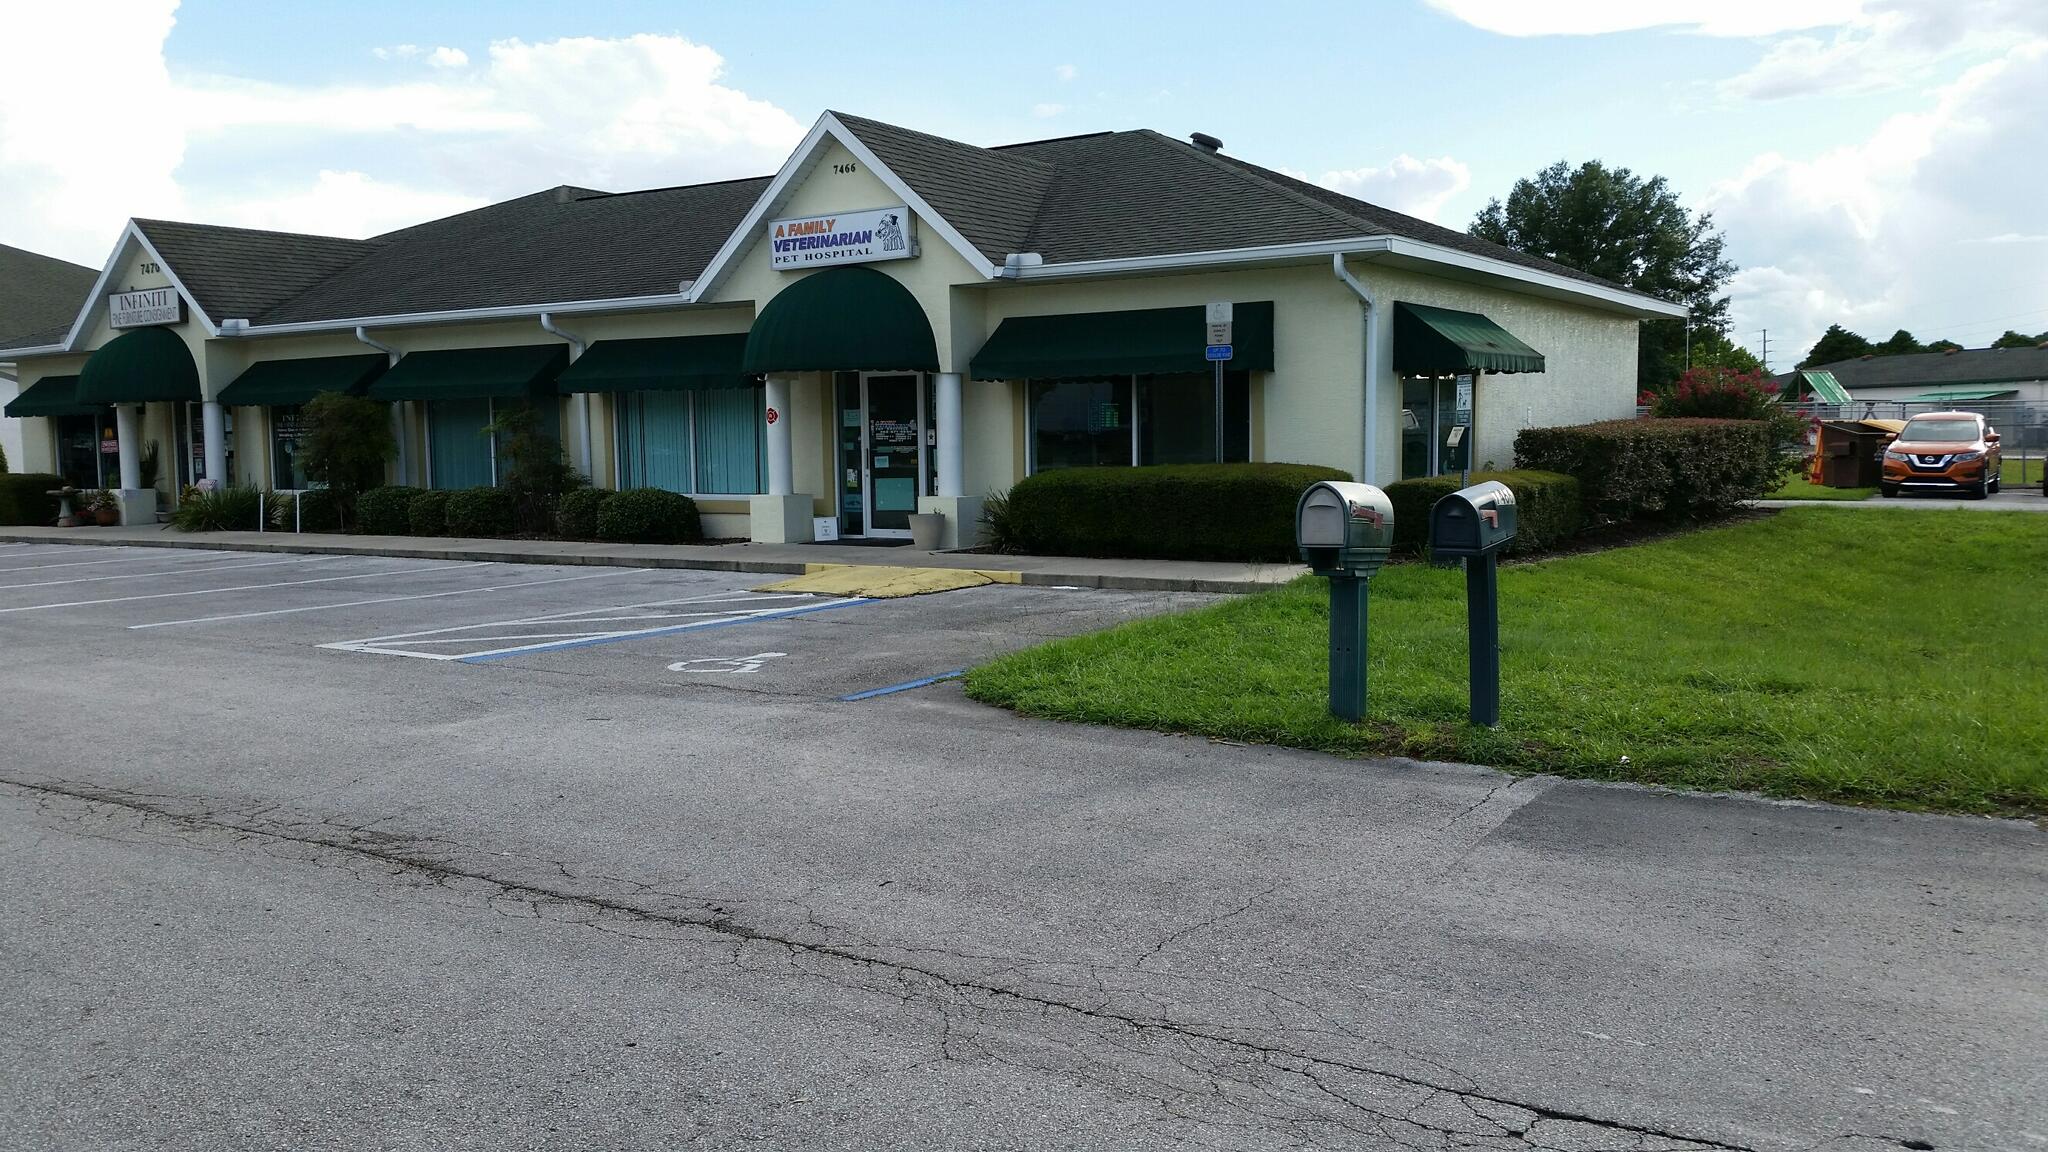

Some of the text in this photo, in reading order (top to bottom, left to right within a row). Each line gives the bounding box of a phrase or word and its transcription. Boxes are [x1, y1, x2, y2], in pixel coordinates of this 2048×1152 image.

[833, 163, 856, 175] 7466
[775, 219, 836, 238] A FAMILY
[774, 230, 873, 253] VETERINARIAN
[775, 248, 873, 264] PET HOSPITAL
[120, 290, 167, 311] INFINITI
